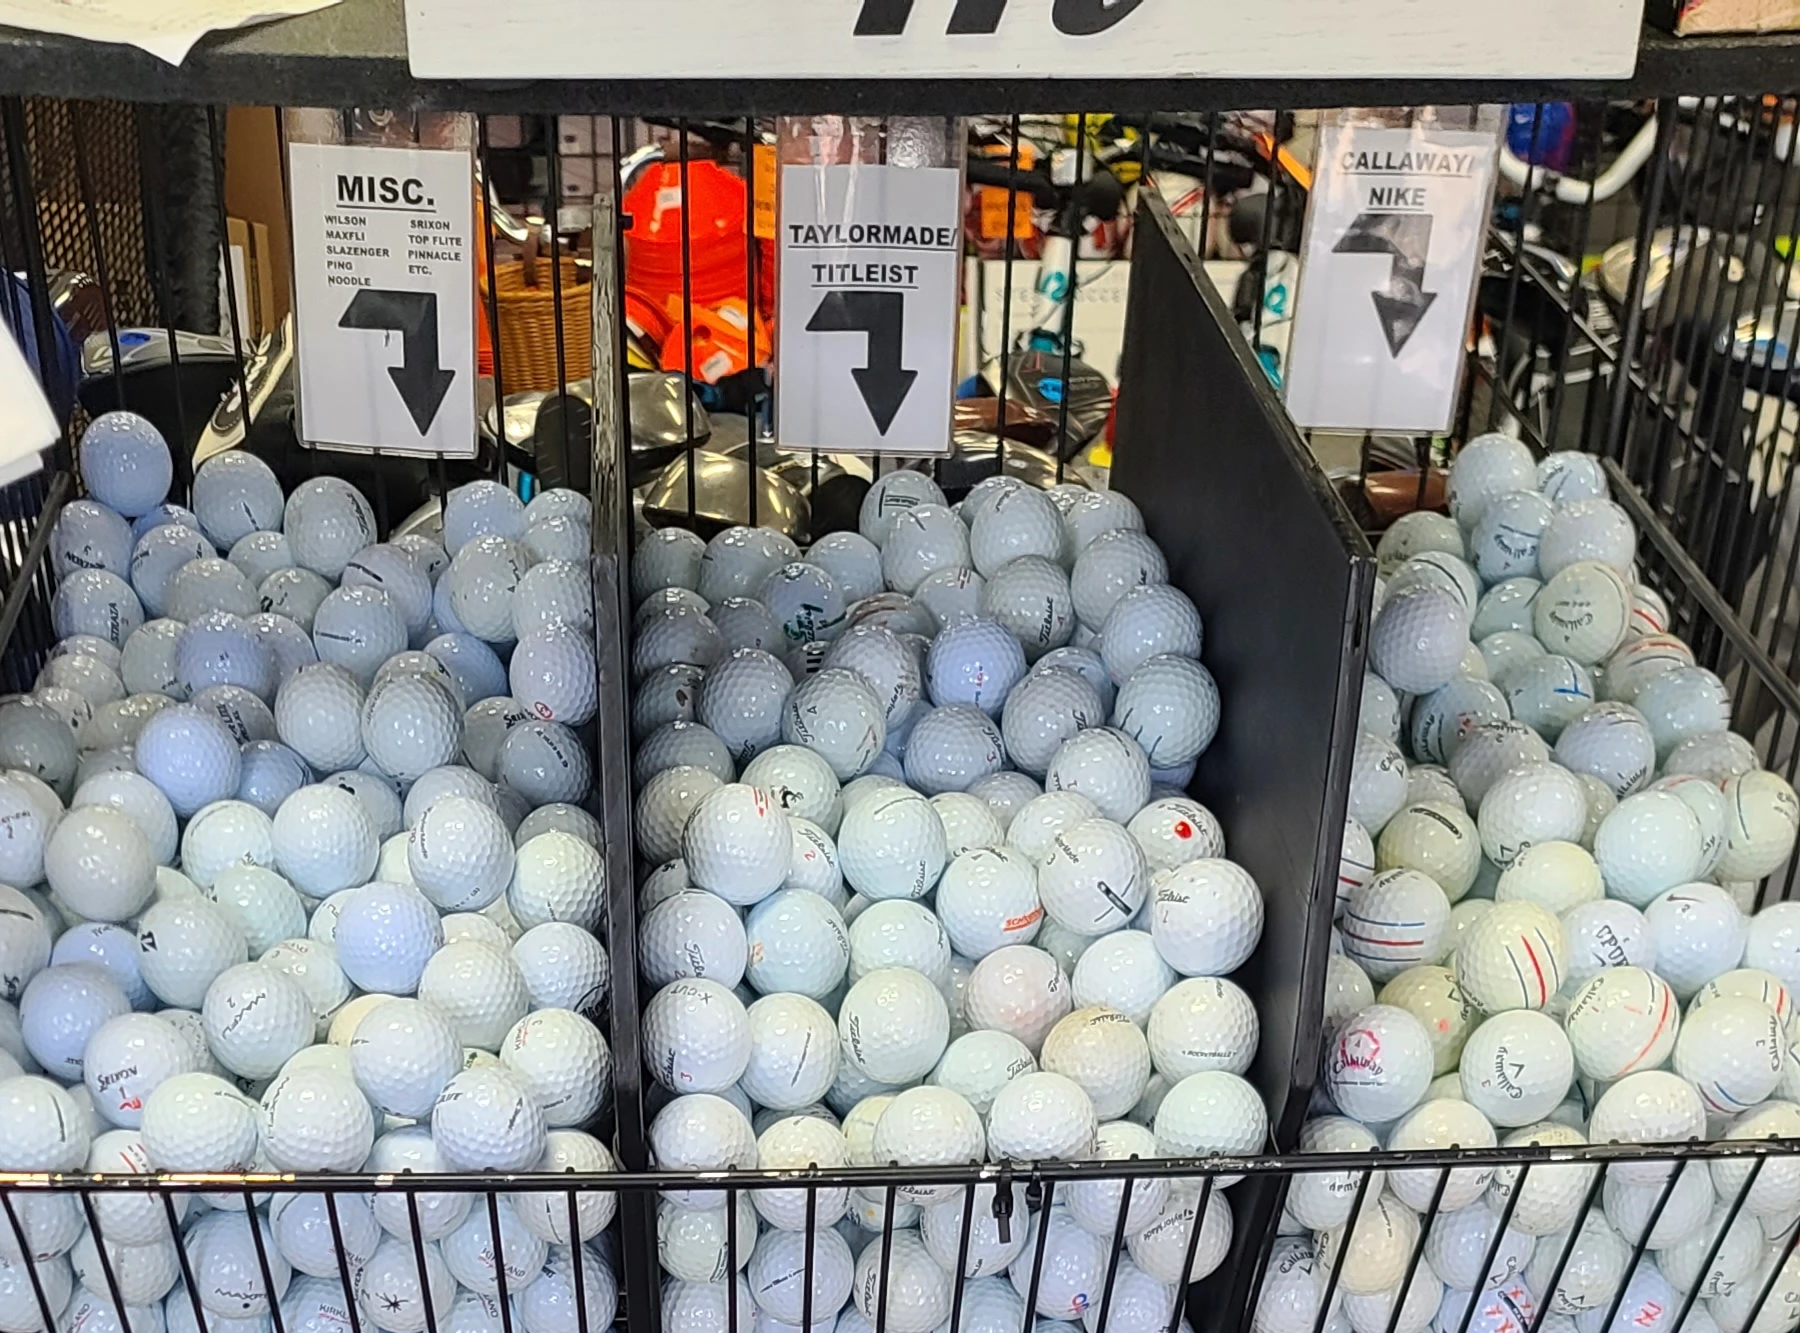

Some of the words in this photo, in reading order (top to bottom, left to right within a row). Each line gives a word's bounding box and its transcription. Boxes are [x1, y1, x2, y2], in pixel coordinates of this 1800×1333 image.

[1341, 151, 1473, 172] CALLAWAY/
[337, 175, 434, 206] MISC.
[1369, 188, 1426, 206] NIKE
[325, 216, 366, 226] WILSON
[410, 220, 450, 230] SRIXON
[326, 230, 365, 241] MAXFLI
[408, 235, 428, 245] TOP
[433, 236, 462, 246] FLITE
[789, 224, 958, 248] TAYLORMADE/
[327, 246, 390, 258] SLAZENGER
[408, 250, 461, 261] PINNACLE
[327, 261, 353, 270] PING
[408, 265, 432, 275] ETC.
[812, 265, 919, 285] TITLEIST
[328, 275, 371, 286] NOODLE
[111, 602, 119, 643] STRATA
[1040, 597, 1054, 645] Titleist
[1550, 610, 1594, 631] Callaway
[1167, 804, 1208, 836] Titleist
[799, 829, 835, 868] Titleist
[911, 860, 926, 898] Titleist
[671, 986, 713, 1005] X-OUT
[850, 1013, 866, 1065] Titleist
[1006, 1058, 1033, 1081] Titleist
[1333, 1055, 1383, 1076] Callaway
[1495, 1046, 1522, 1099] Callaway
[98, 1066, 138, 1092] SRIXON
[482, 1247, 526, 1277] KILAND
[1280, 1251, 1314, 1273] Callaw
[215, 1288, 269, 1300] MAXFI
[864, 1268, 877, 1316] Titleist
[320, 1304, 366, 1327] KIRKLD
